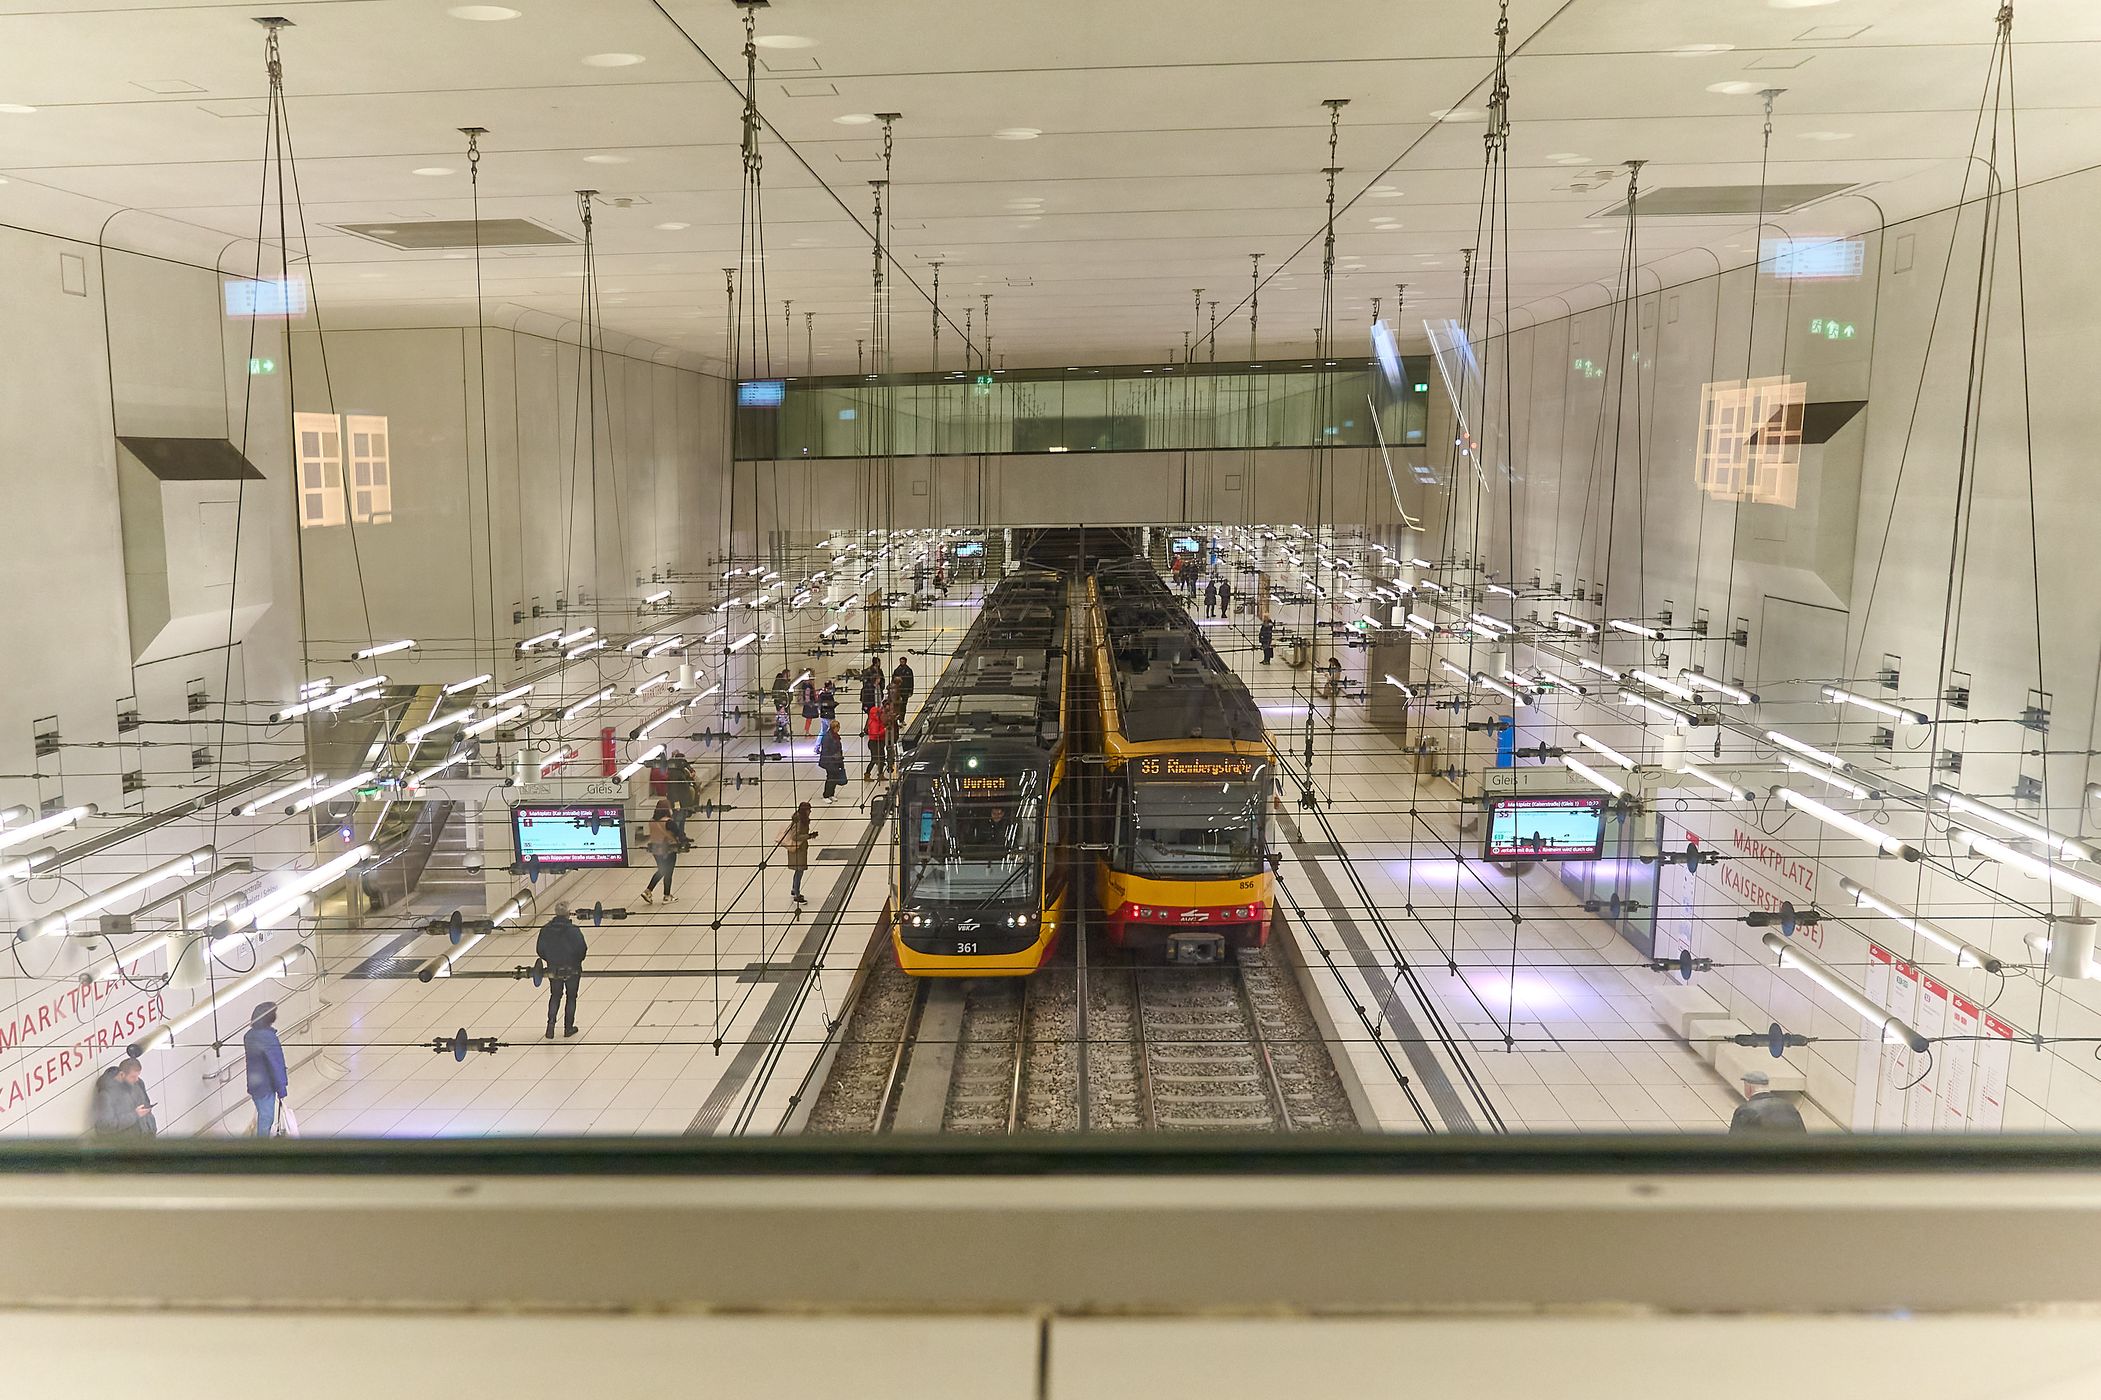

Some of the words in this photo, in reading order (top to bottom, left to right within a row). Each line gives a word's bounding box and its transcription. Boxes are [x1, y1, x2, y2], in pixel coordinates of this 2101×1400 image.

[963, 777, 1005, 789] Durlach
[1492, 775, 1519, 785] Gleis
[1524, 775, 1528, 785] 1
[587, 784, 613, 794] Gleis
[616, 784, 623, 794] 2
[1733, 828, 1814, 892] MARKTPLATZ
[1239, 880, 1254, 889] 856
[957, 943, 977, 953] 361
